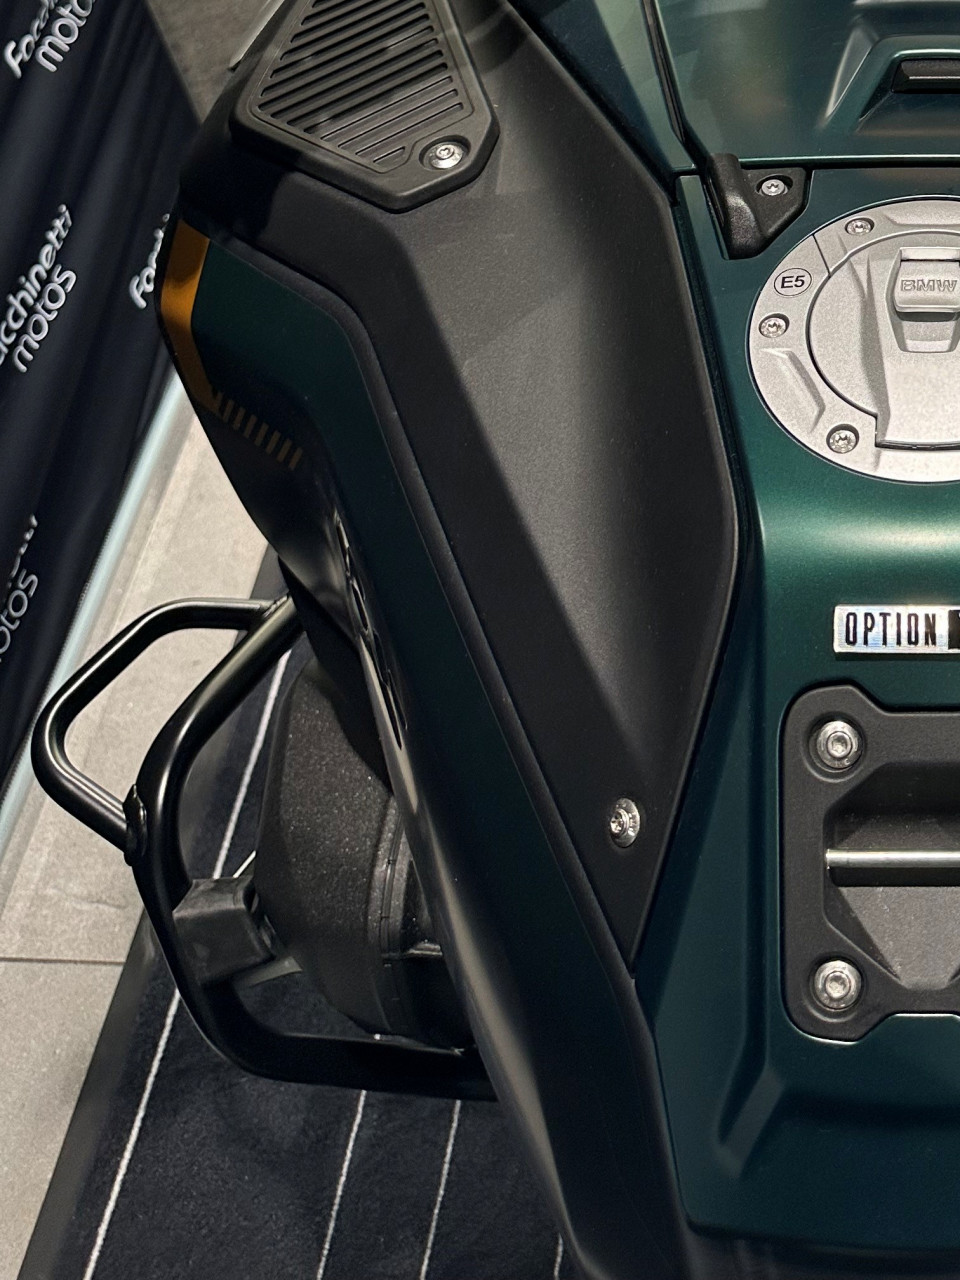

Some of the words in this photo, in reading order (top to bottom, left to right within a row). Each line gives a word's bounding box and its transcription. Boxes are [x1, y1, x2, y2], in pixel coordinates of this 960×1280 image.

[0, 204, 72, 366] cchinetti
[780, 275, 805, 288] E5
[900, 279, 958, 293] BMW
[12, 264, 77, 373] motos
[0, 569, 39, 654] otos
[845, 612, 937, 648] OPTION
